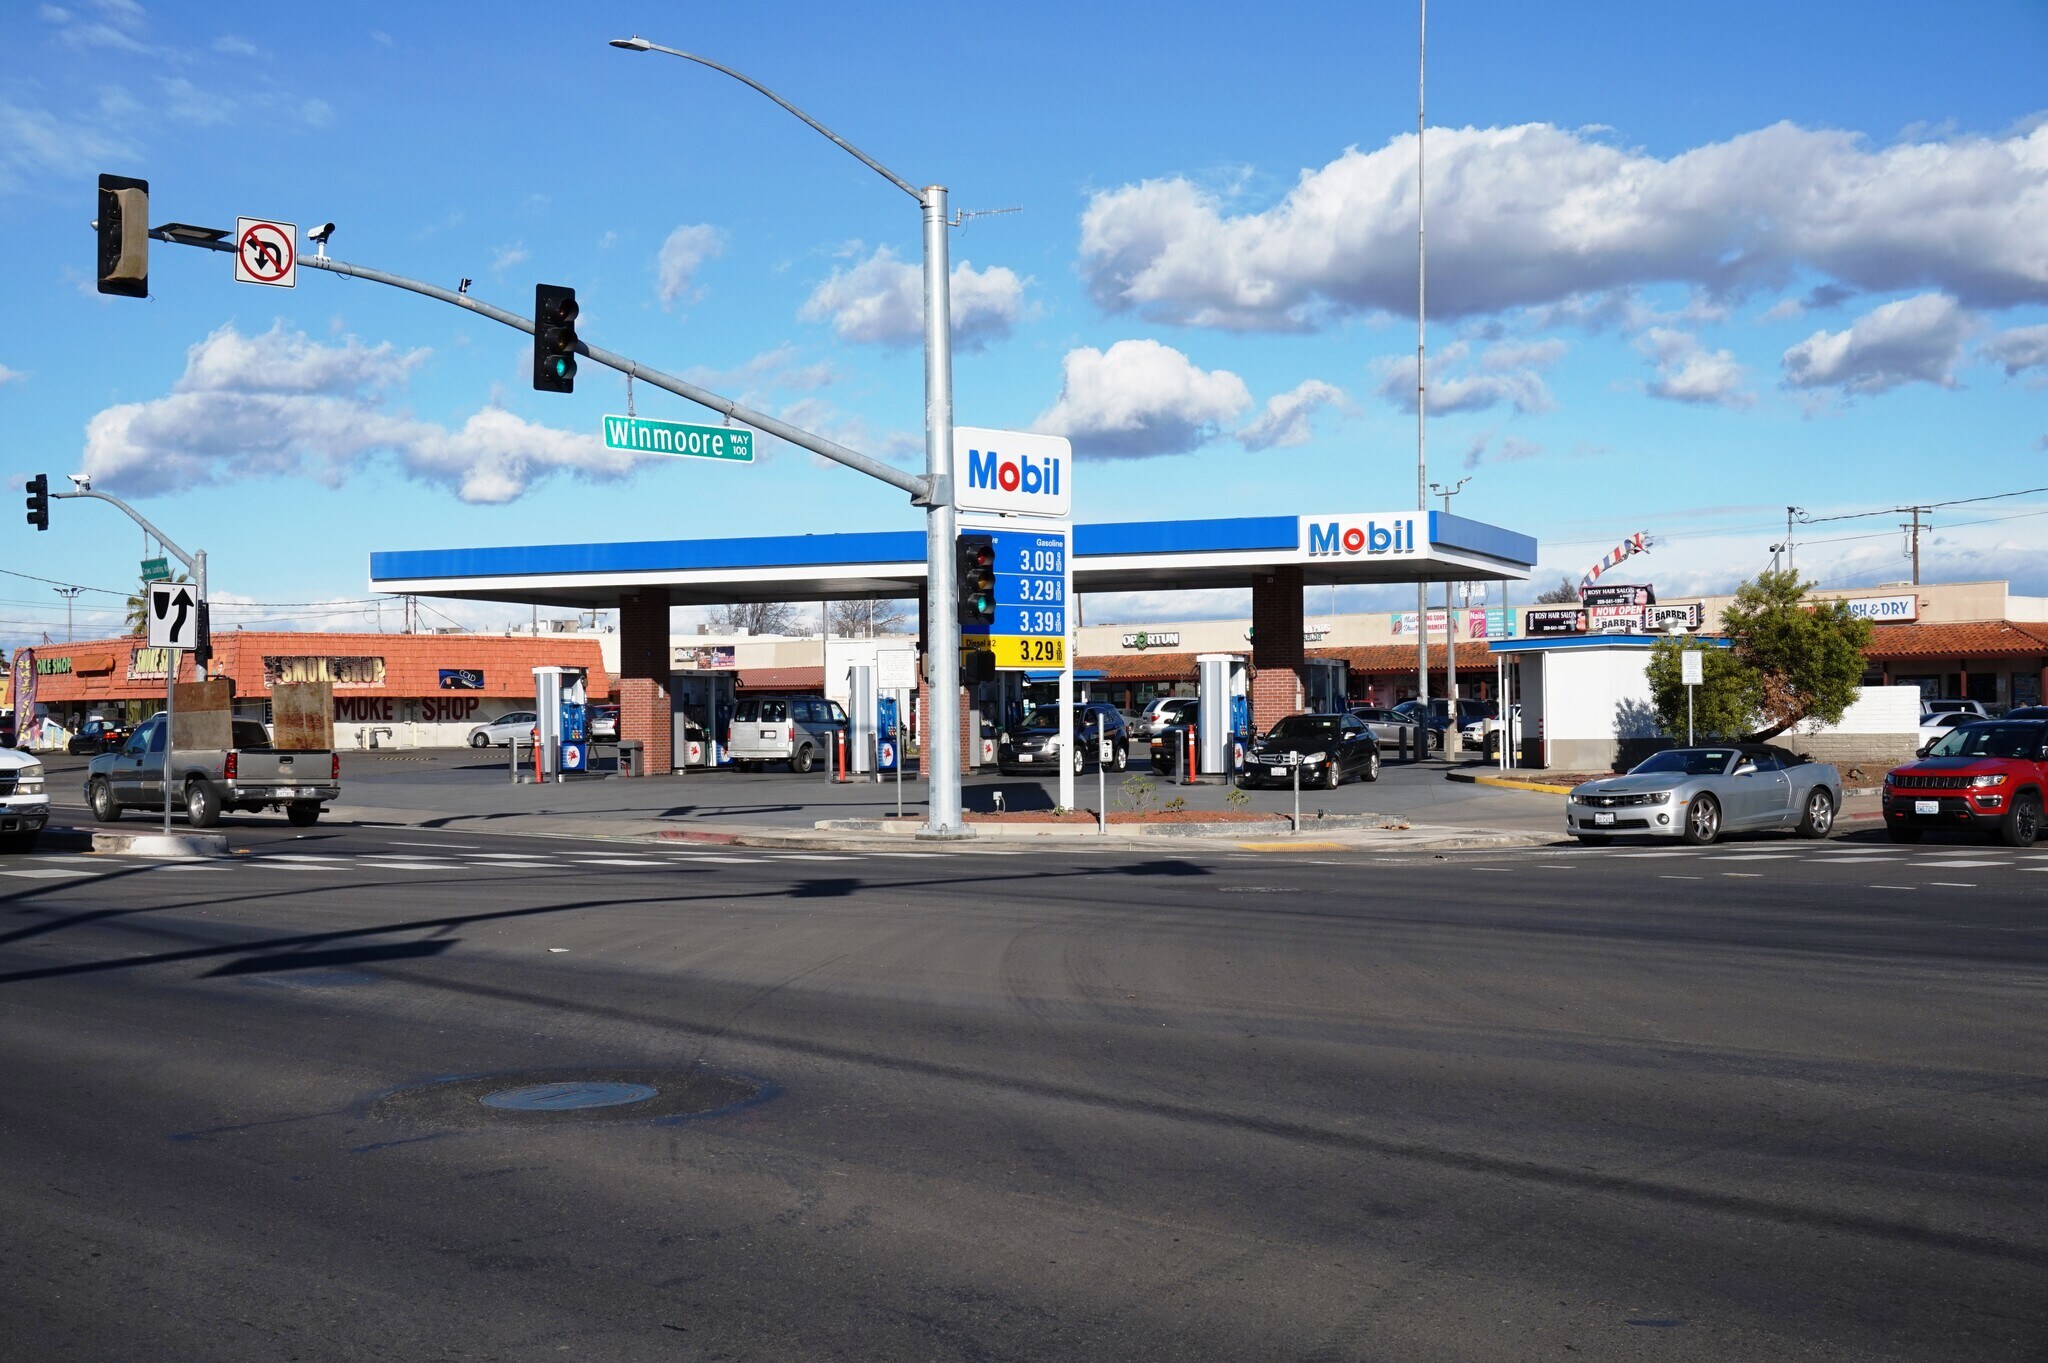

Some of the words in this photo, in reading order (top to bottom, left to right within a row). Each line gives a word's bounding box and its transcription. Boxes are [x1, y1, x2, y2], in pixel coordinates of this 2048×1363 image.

[609, 420, 724, 455] Winmoore
[730, 434, 749, 444] WAY
[733, 446, 747, 455] 100
[969, 449, 1059, 495] Mobil
[1036, 538, 1064, 548] Gasoline
[1309, 519, 1413, 552] Mobil
[1020, 549, 1054, 572] 3.09
[1020, 579, 1054, 601] 3.29
[1469, 611, 1486, 620] Nails
[1548, 611, 1560, 619] HAIR
[1561, 611, 1576, 619] SALON
[1596, 606, 1617, 616] NOW
[1618, 605, 1643, 615] OPEN
[1655, 610, 1687, 622] BARBER
[1869, 603, 1880, 615] &
[1881, 601, 1908, 616] DRY
[1020, 611, 1054, 633] 3.39
[1601, 619, 1638, 629] BARBER
[1020, 639, 1054, 661] 3.29
[53, 657, 72, 674] SHOP
[281, 656, 338, 683] SMOKE
[340, 656, 384, 683] SHOP
[335, 697, 394, 721] MOKE
[421, 697, 480, 721] SHOP
